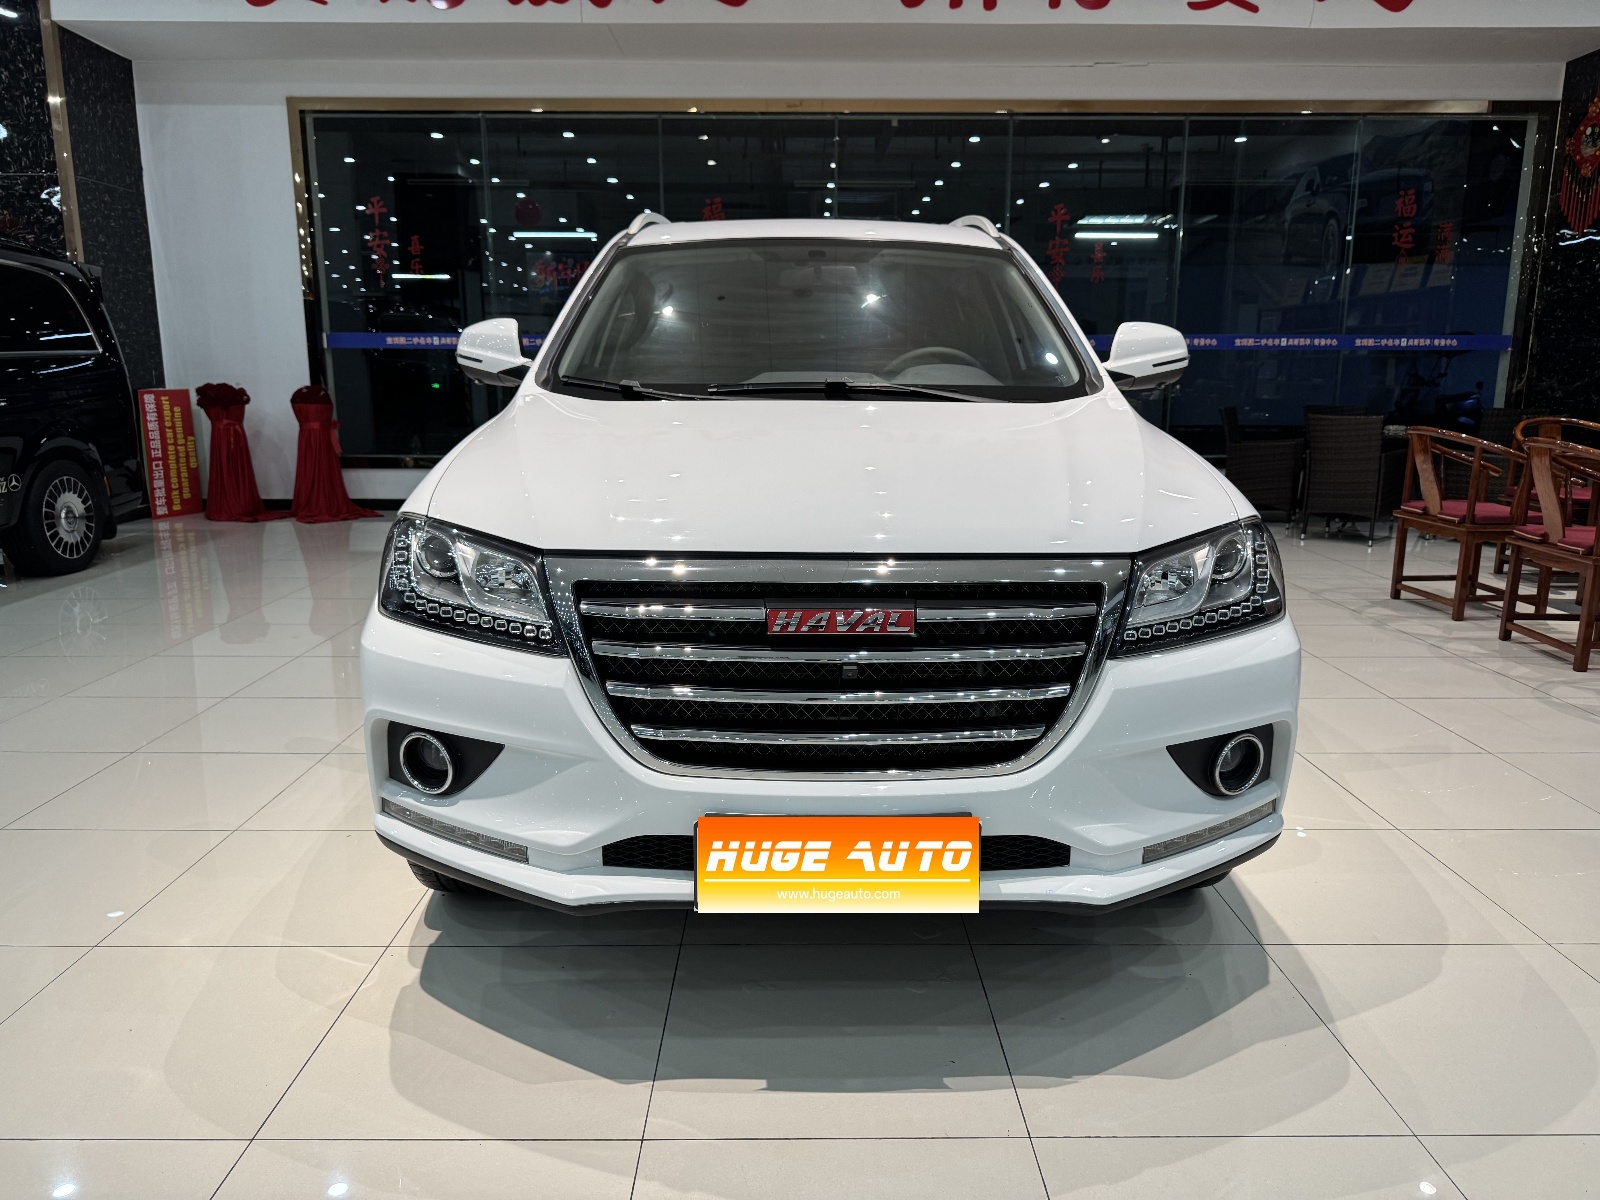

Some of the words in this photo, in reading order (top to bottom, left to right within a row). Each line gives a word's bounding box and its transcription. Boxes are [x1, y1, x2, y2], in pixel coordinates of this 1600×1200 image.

[365, 196, 391, 258] 平安
[1046, 203, 1071, 266] 平安
[161, 396, 172, 428] export
[173, 406, 186, 444] genuine
[165, 428, 174, 444] car
[187, 436, 198, 468] quality
[168, 445, 179, 489] complete
[177, 444, 191, 499] guaranteed
[171, 489, 181, 511] Bulk
[772, 611, 911, 632] HAVAL
